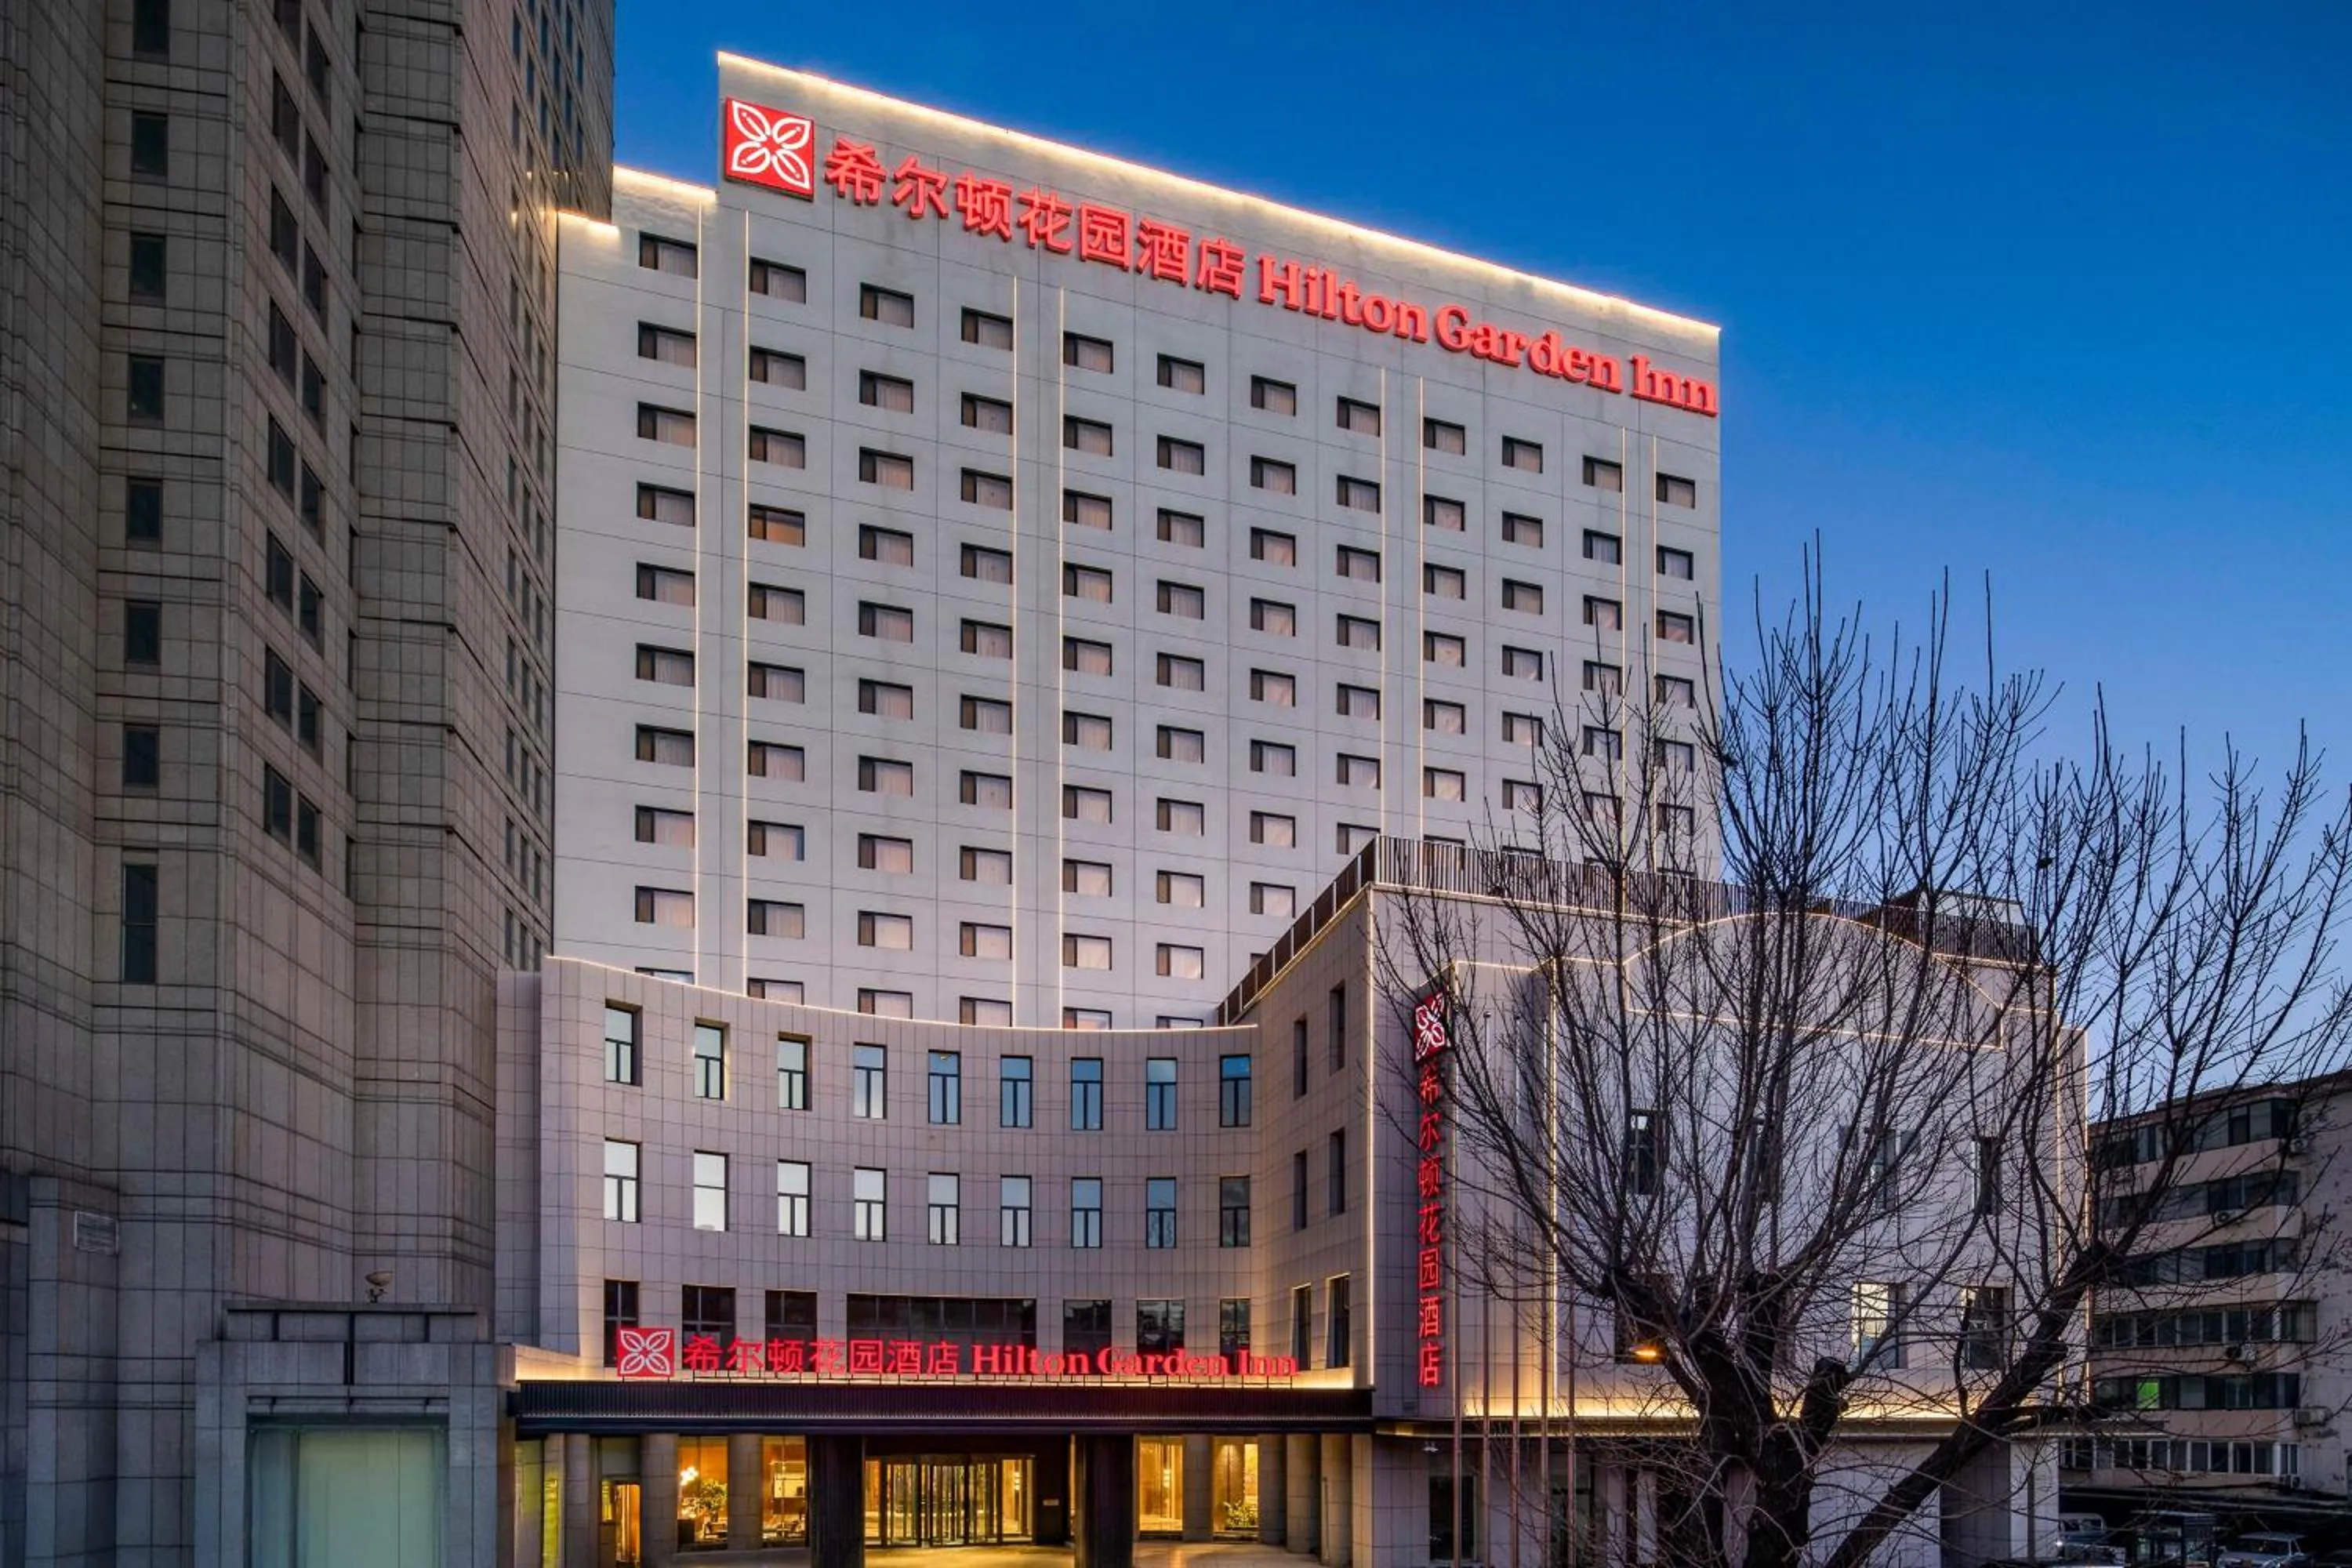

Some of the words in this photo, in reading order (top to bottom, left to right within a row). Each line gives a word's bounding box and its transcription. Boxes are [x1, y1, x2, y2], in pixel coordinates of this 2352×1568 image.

[826, 139, 1245, 298] 希尔顿花园酒店
[1259, 256, 1428, 343] Hilton
[1435, 304, 1621, 393] Garden
[1631, 354, 1717, 417] Inn
[684, 1336, 959, 1374] 希尔顿花园酒店
[972, 1344, 1090, 1374] Hilton
[1098, 1346, 1230, 1376] Garden
[1238, 1348, 1298, 1377] Inn
[1417, 1063, 1441, 1385] 希尔顿花园酒店
